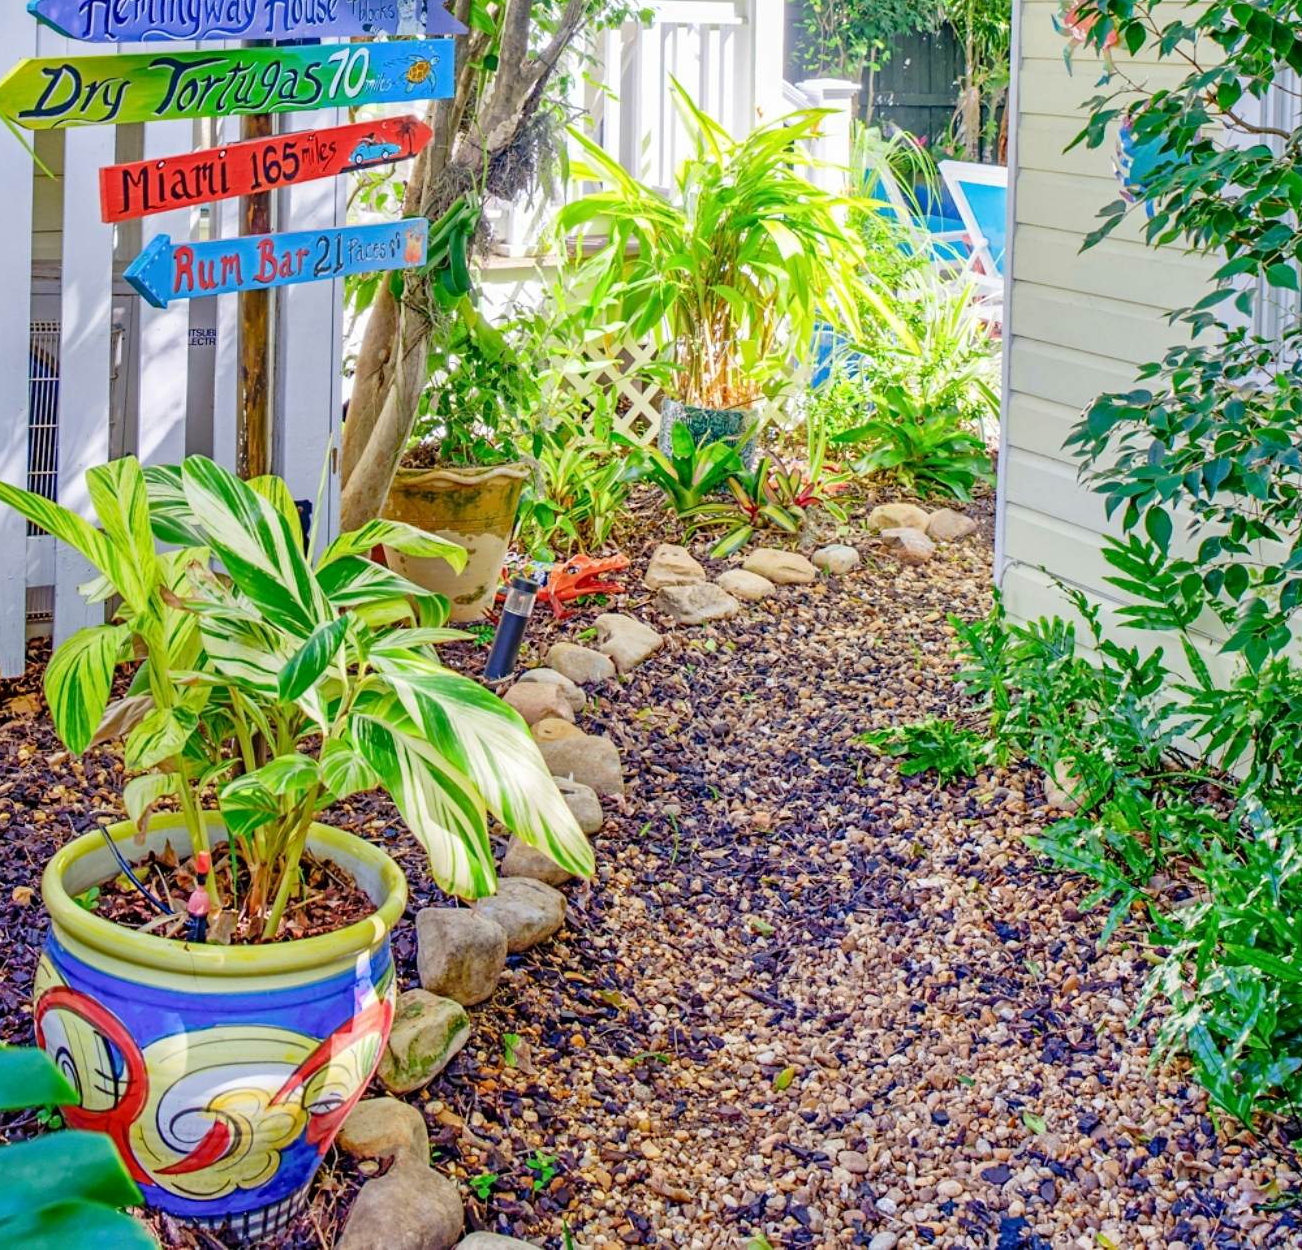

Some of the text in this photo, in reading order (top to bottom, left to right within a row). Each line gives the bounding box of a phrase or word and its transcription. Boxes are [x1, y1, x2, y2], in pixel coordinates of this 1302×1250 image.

[18, 63, 131, 128] Dry
[148, 56, 323, 116] Tortugas
[328, 48, 370, 99] 70
[118, 134, 337, 214] Miami 165 miles
[173, 245, 243, 293] Rum
[253, 238, 310, 284] Bar
[313, 233, 344, 277] 21
